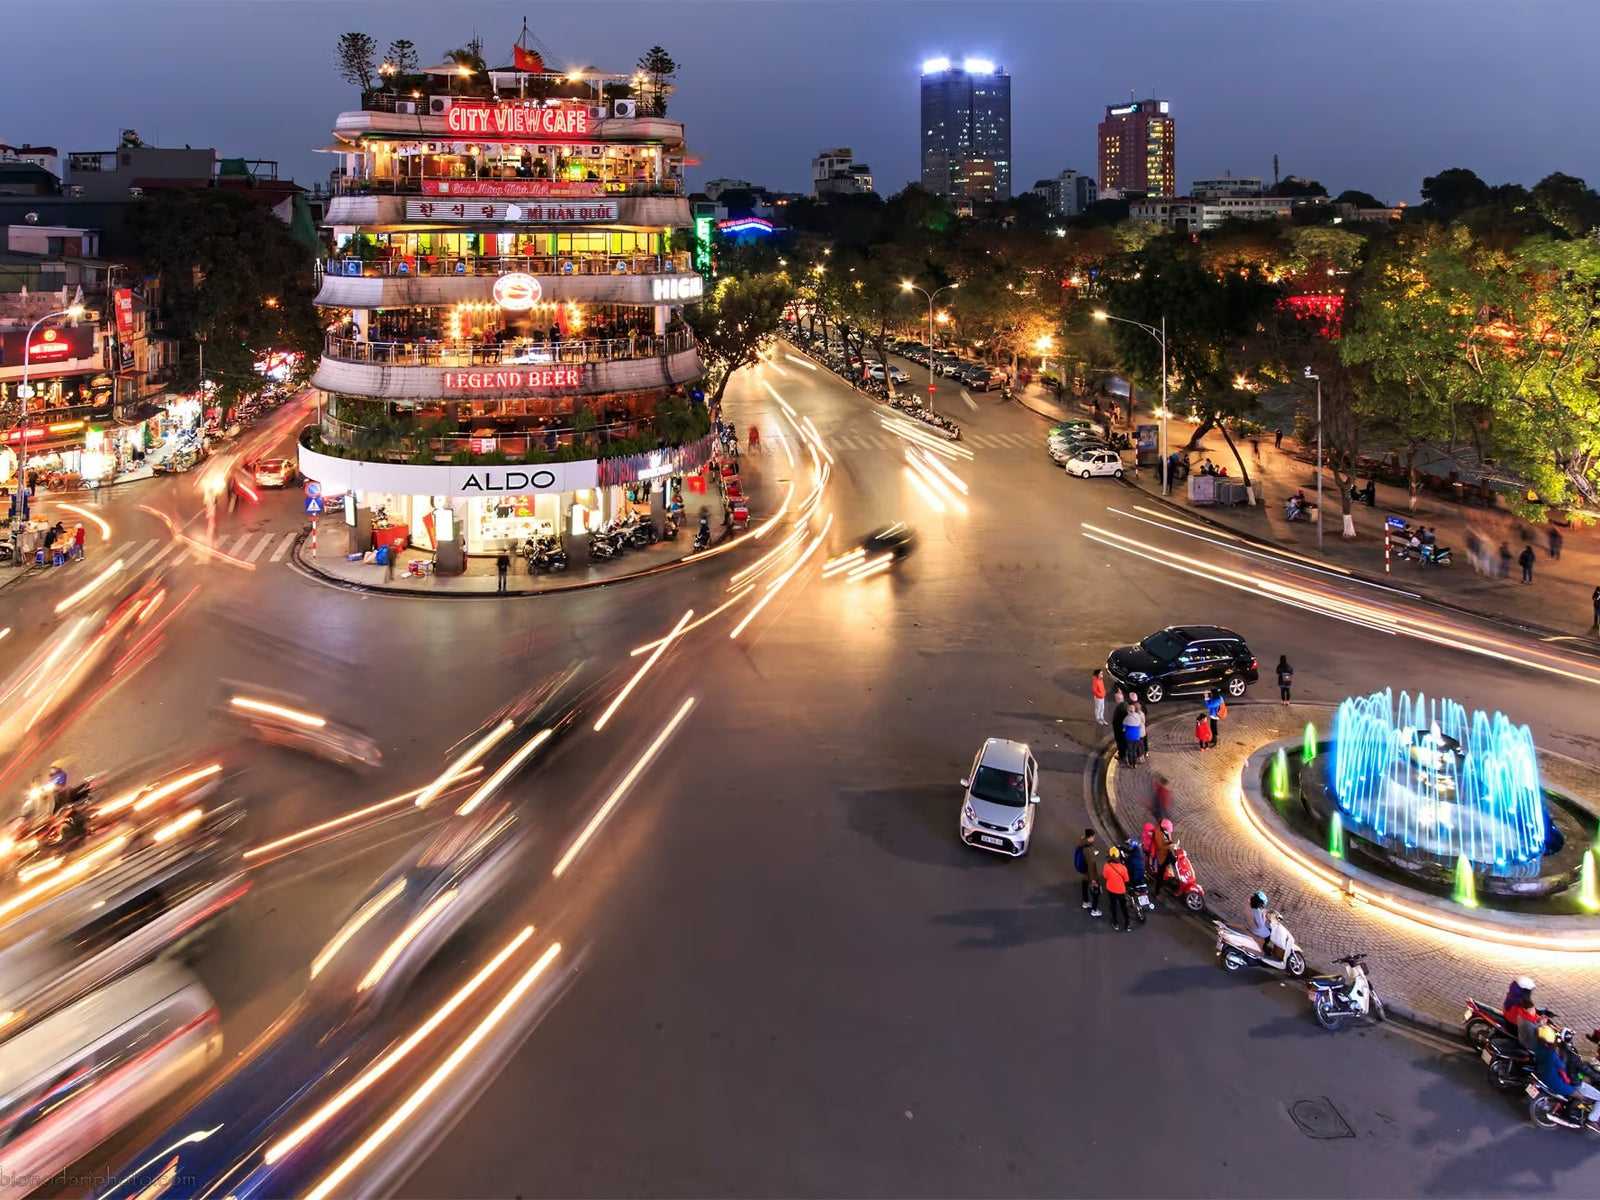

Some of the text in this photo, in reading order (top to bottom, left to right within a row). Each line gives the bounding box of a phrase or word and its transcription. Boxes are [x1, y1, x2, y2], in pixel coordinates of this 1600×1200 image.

[449, 107, 587, 132] CITY VIEW CAFE
[547, 204, 575, 220] HÀN
[446, 370, 578, 389] LEGEND BEER
[461, 470, 556, 491] ALDO
